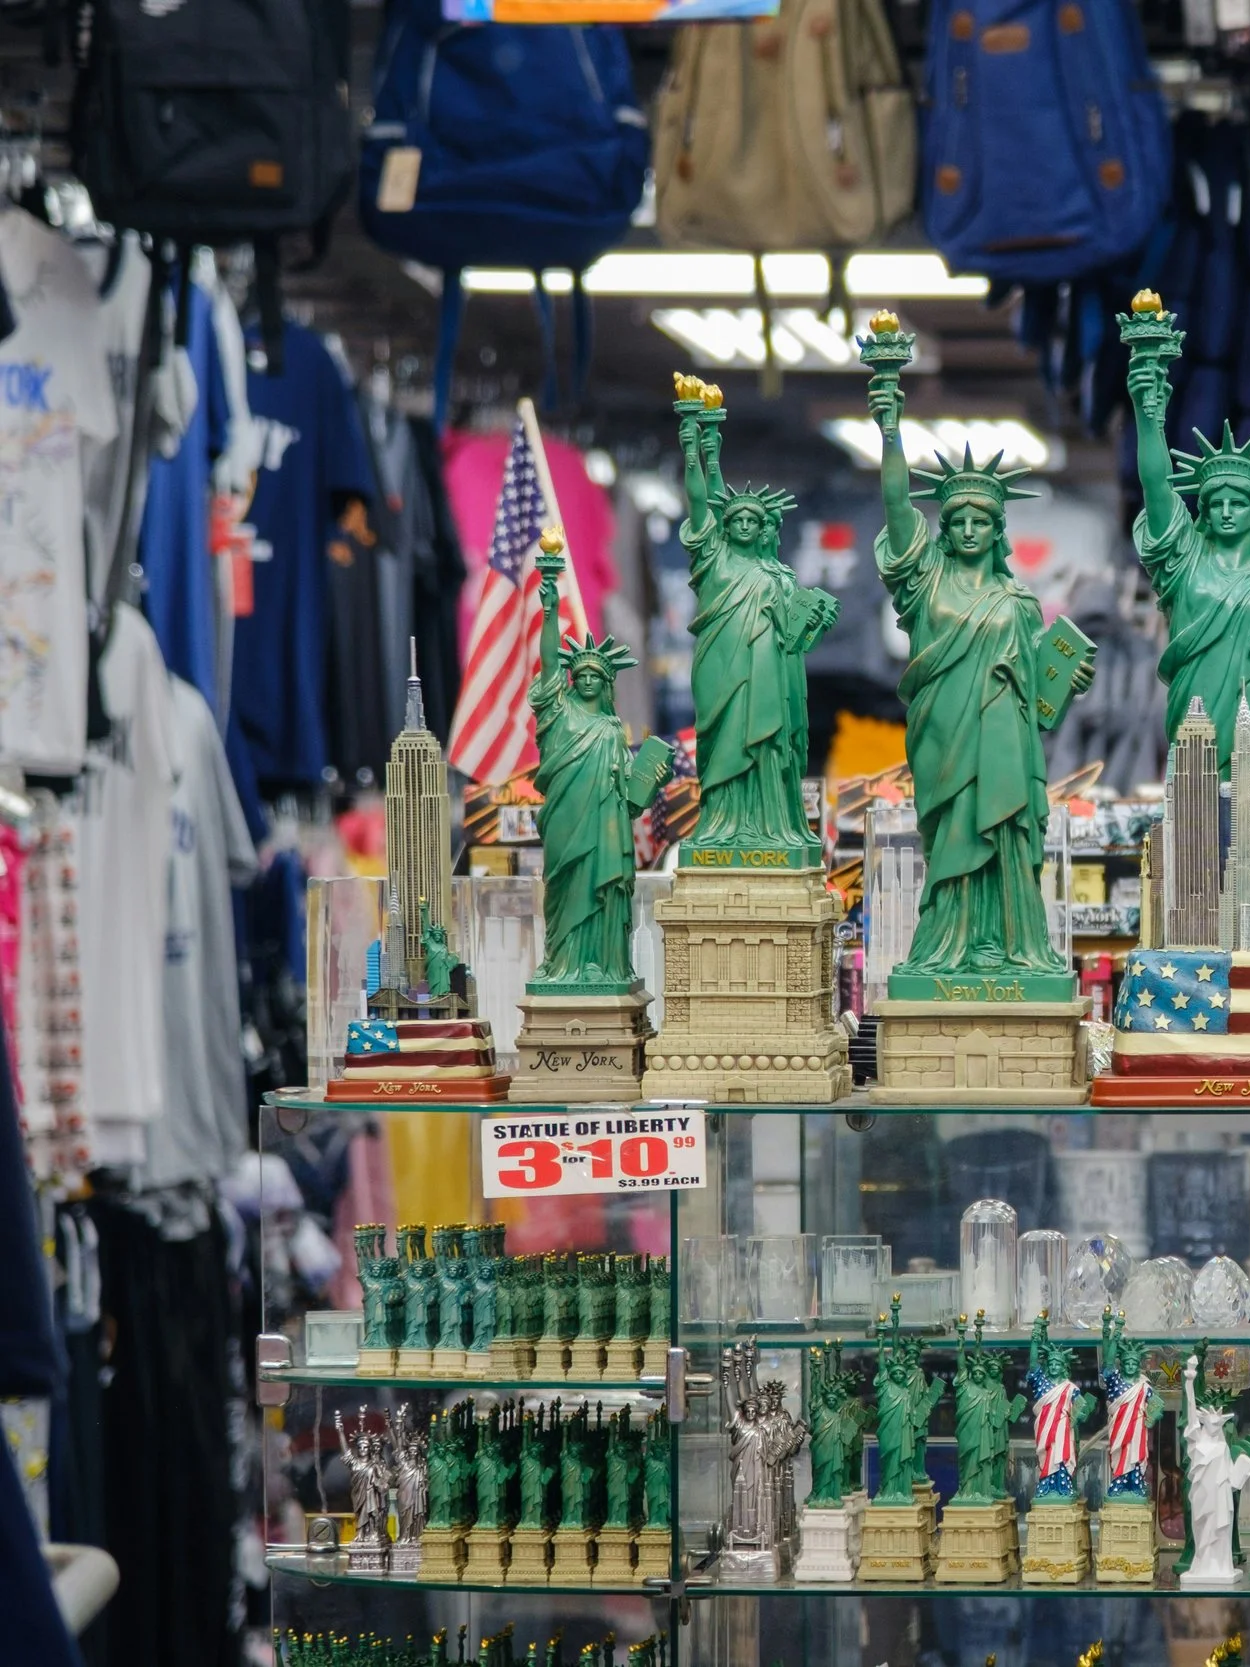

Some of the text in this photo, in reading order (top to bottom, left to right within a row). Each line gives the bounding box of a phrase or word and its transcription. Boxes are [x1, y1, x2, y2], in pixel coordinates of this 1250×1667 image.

[691, 849, 790, 867] NEW YORK
[933, 977, 1026, 1002] New York
[529, 1051, 572, 1072] NEW
[575, 1051, 623, 1072] YORK
[493, 1116, 691, 1140] STATUE OF LIBERTY
[497, 1139, 563, 1190] 3
[561, 1155, 587, 1164] for
[617, 1175, 700, 1188] $3.99 EACH
